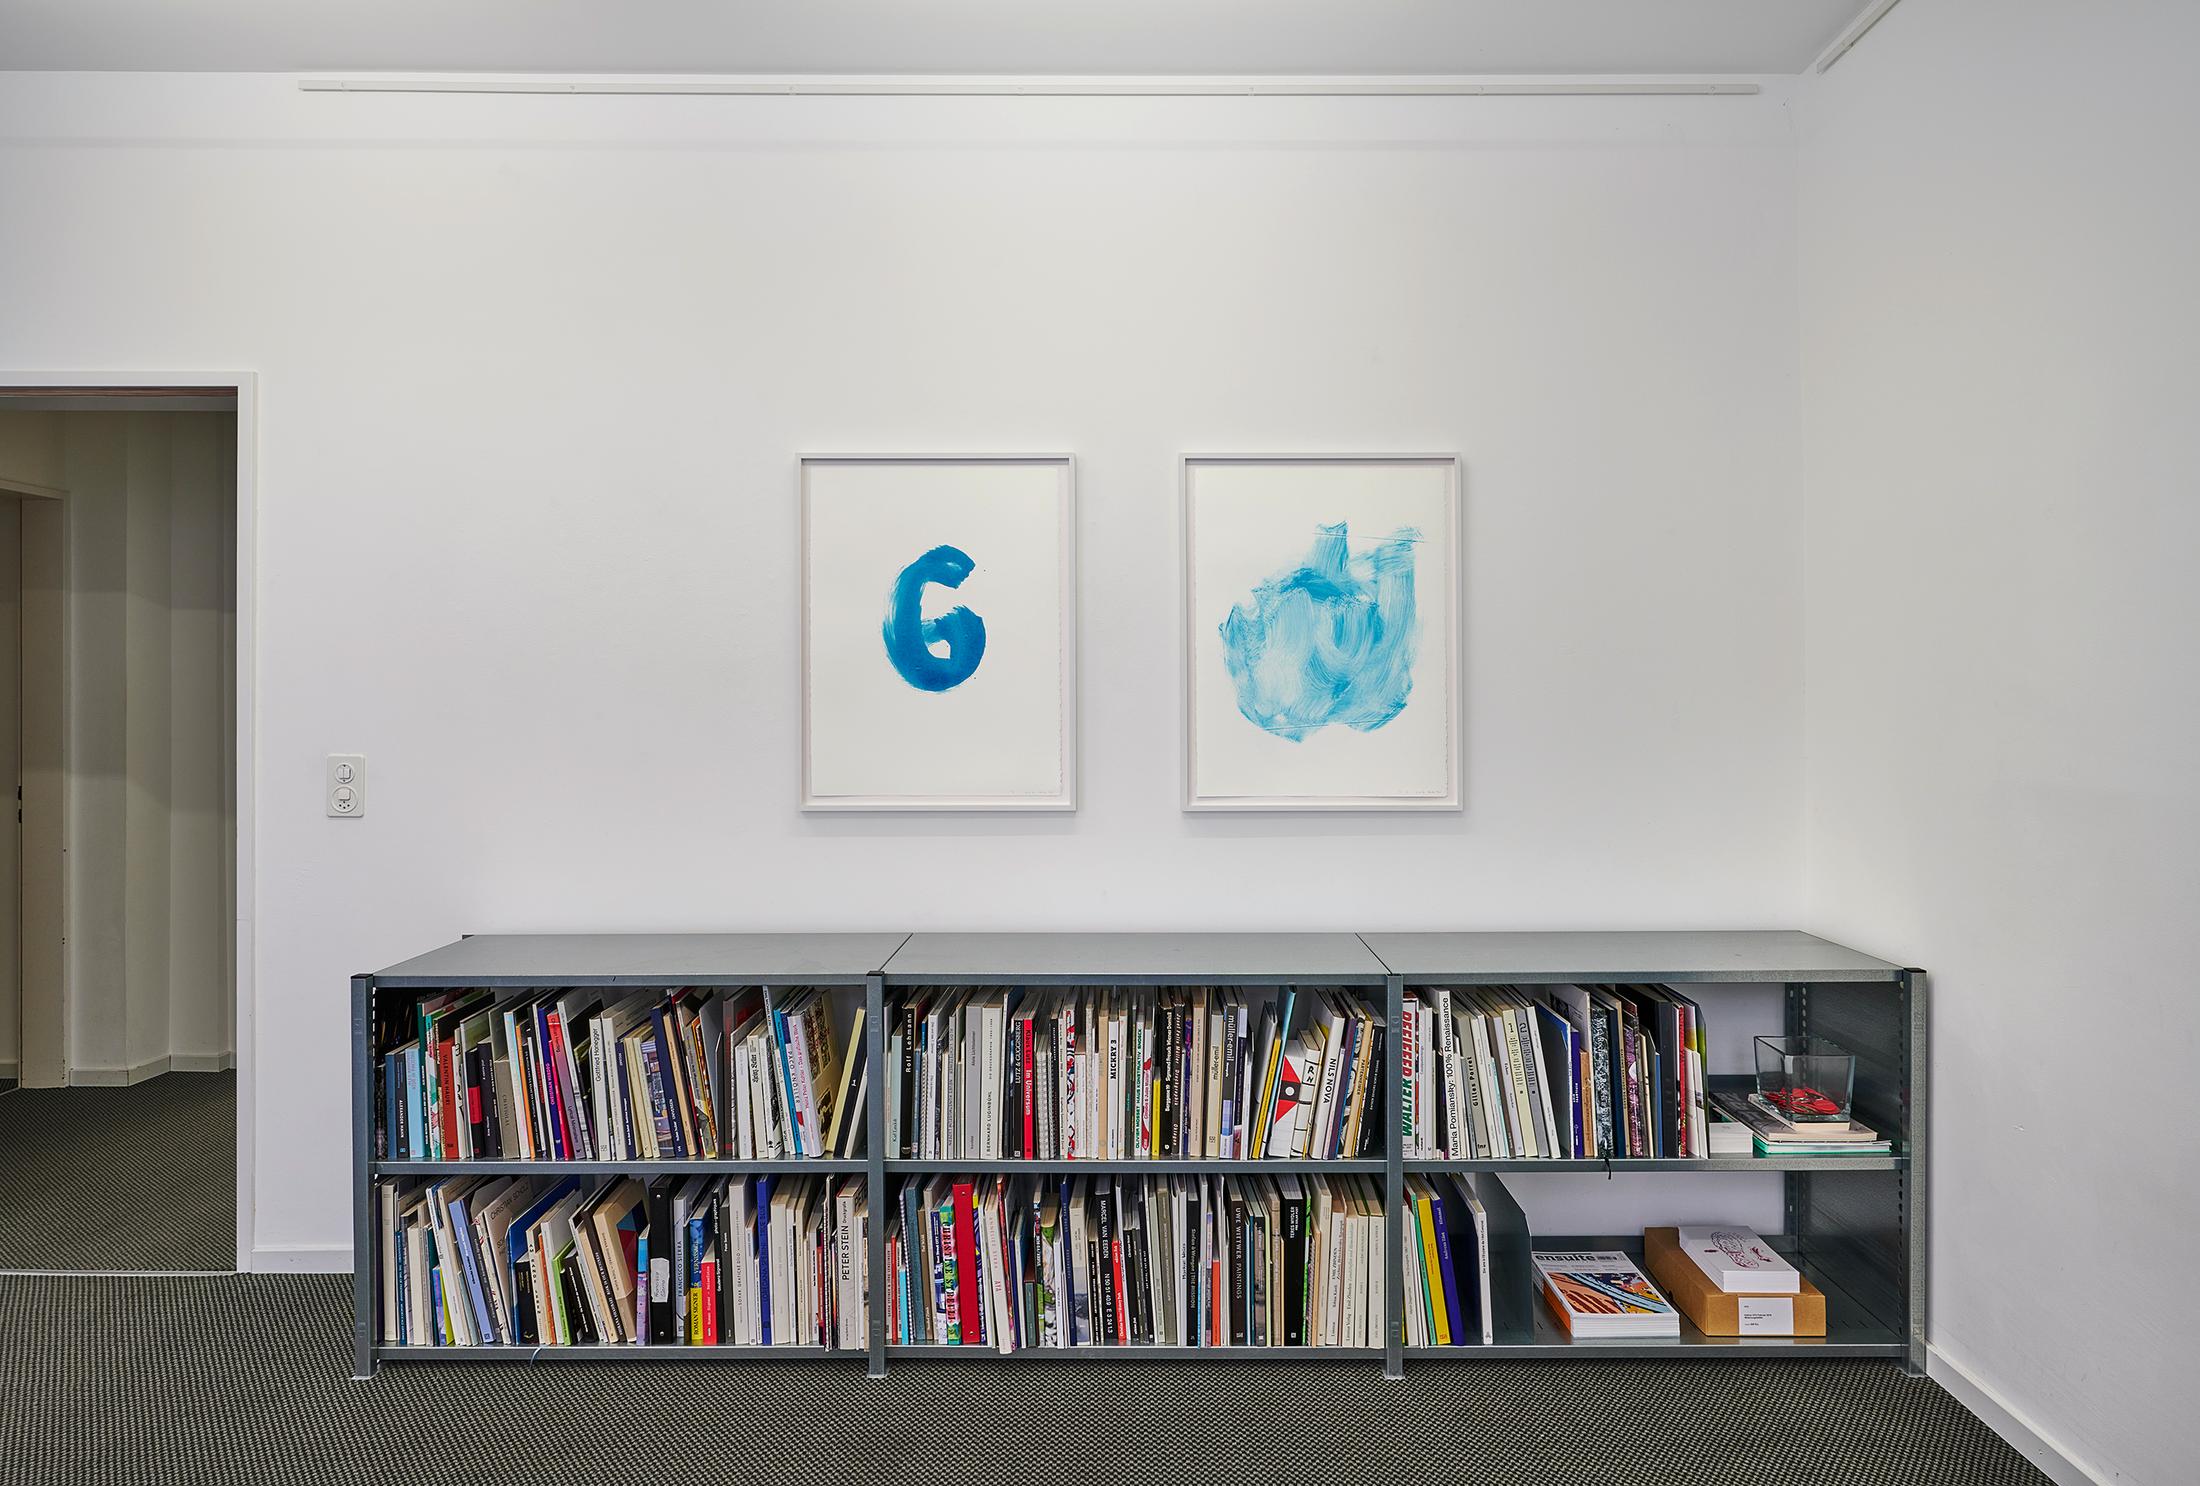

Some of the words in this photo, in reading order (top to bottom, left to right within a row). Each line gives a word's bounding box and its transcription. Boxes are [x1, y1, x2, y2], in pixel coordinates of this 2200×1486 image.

[1226, 1014, 1235, 1062] müller-emil
[1442, 997, 1452, 1052] Renaissance
[592, 1028, 600, 1056] Honegger
[1014, 1021, 1022, 1061] GUGGISBERG
[594, 1056, 602, 1082] Gottfried
[1025, 1069, 1032, 1078] Im
[1211, 1045, 1220, 1081] müller-emil
[1327, 1058, 1337, 1077] NILS
[1356, 1059, 1365, 1095] PARTENHEIMER
[1445, 1054, 1453, 1078] 100%
[1467, 1056, 1475, 1081] Porret
[791, 1072, 800, 1104] KNÖLLER
[1173, 1069, 1181, 1106] Druckgraphik
[1323, 1078, 1334, 1104] NOVA
[1471, 1083, 1479, 1107] Gilles
[1447, 1080, 1456, 1129] Pomiansky:
[1451, 1130, 1459, 1157] Maria
[841, 1226, 849, 1251] STEIN
[942, 1221, 953, 1274] CHRISTINE
[842, 1253, 850, 1281] PETER
[1534, 1254, 1597, 1262] ensuite
[1235, 1263, 1243, 1299] PAINTINGS
[945, 1278, 956, 1321] STREULI
